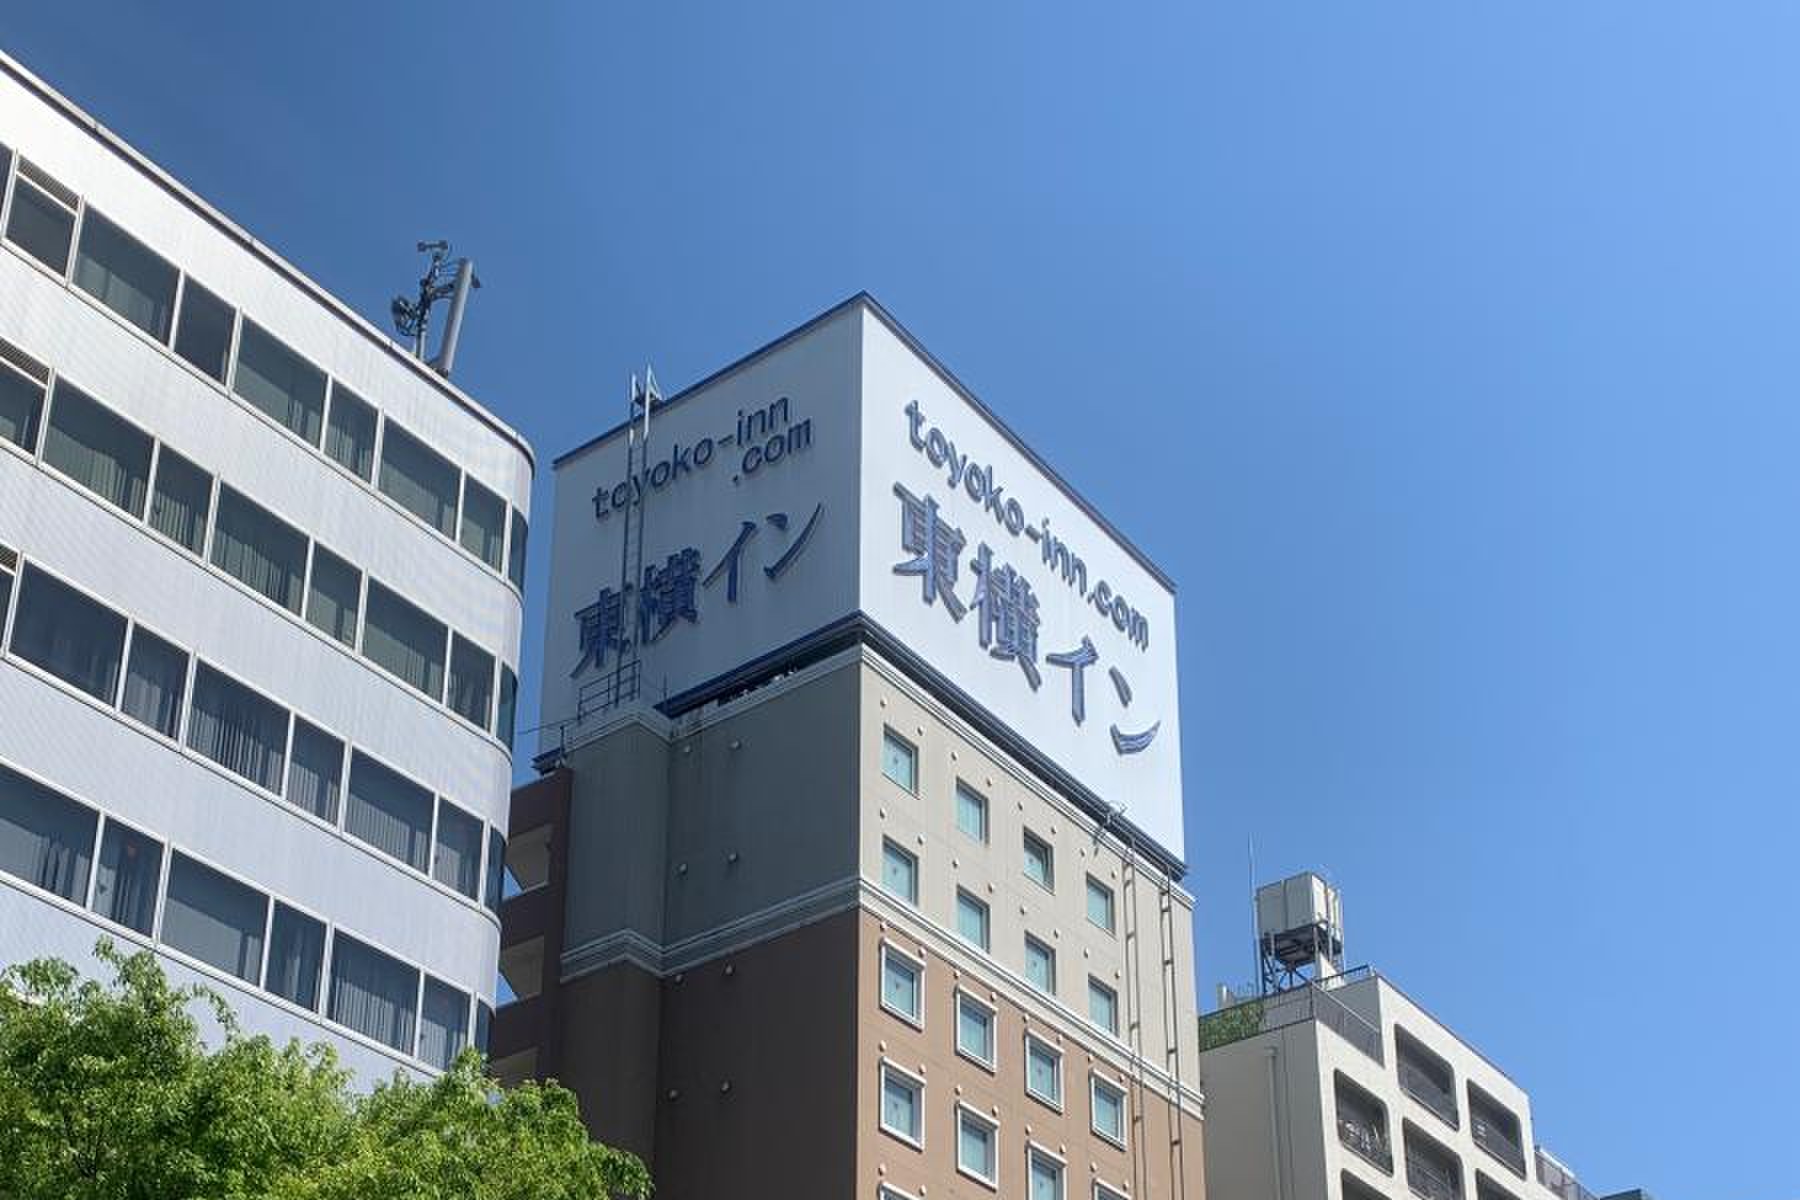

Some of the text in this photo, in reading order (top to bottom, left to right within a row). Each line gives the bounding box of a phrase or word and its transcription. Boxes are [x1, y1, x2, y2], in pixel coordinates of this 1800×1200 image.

[592, 397, 790, 520] toyoko-inn
[732, 417, 812, 486] .com
[904, 399, 1150, 652] toyoko-inn.com
[570, 501, 822, 680] 東横イン
[891, 480, 1162, 756] 東横イン
